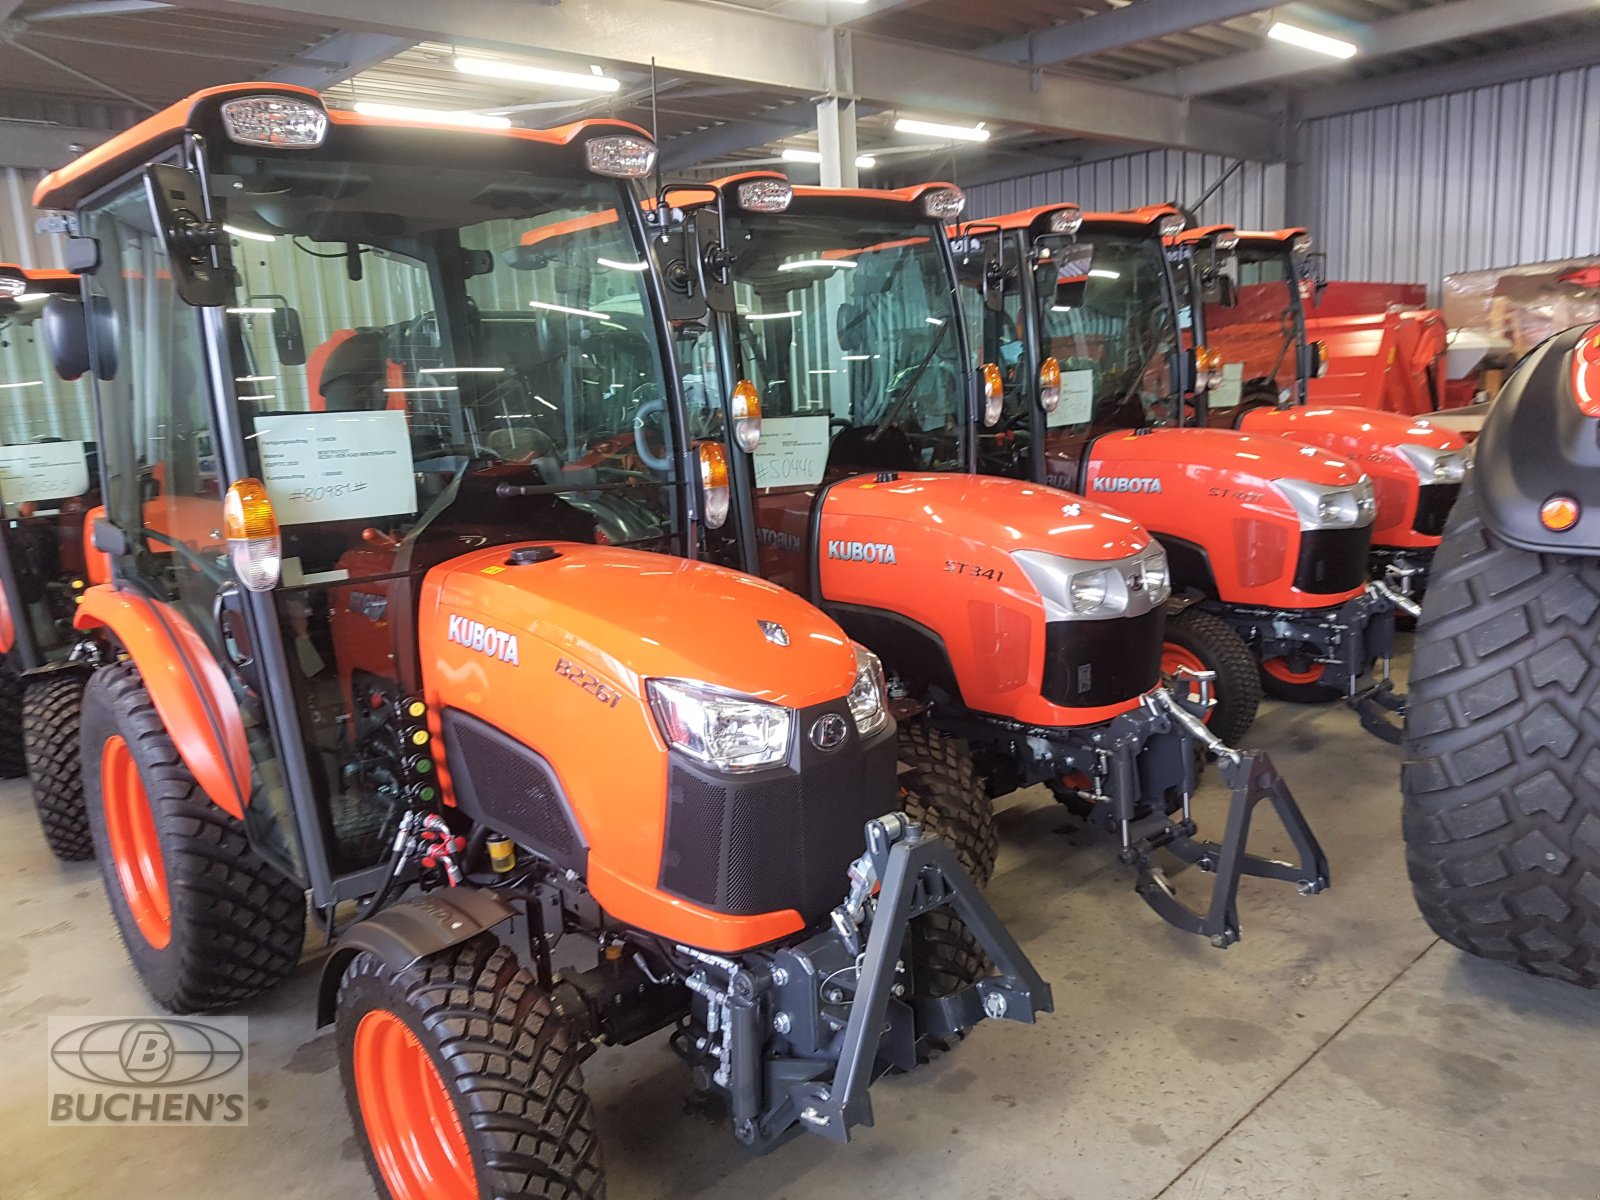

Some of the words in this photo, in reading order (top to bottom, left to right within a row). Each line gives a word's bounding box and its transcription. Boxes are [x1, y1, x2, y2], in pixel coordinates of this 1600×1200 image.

[1093, 476, 1163, 494] KUBOTA
[828, 540, 897, 565] KUBOTA
[447, 613, 519, 667] KUBOTA
[555, 657, 623, 709] B2261
